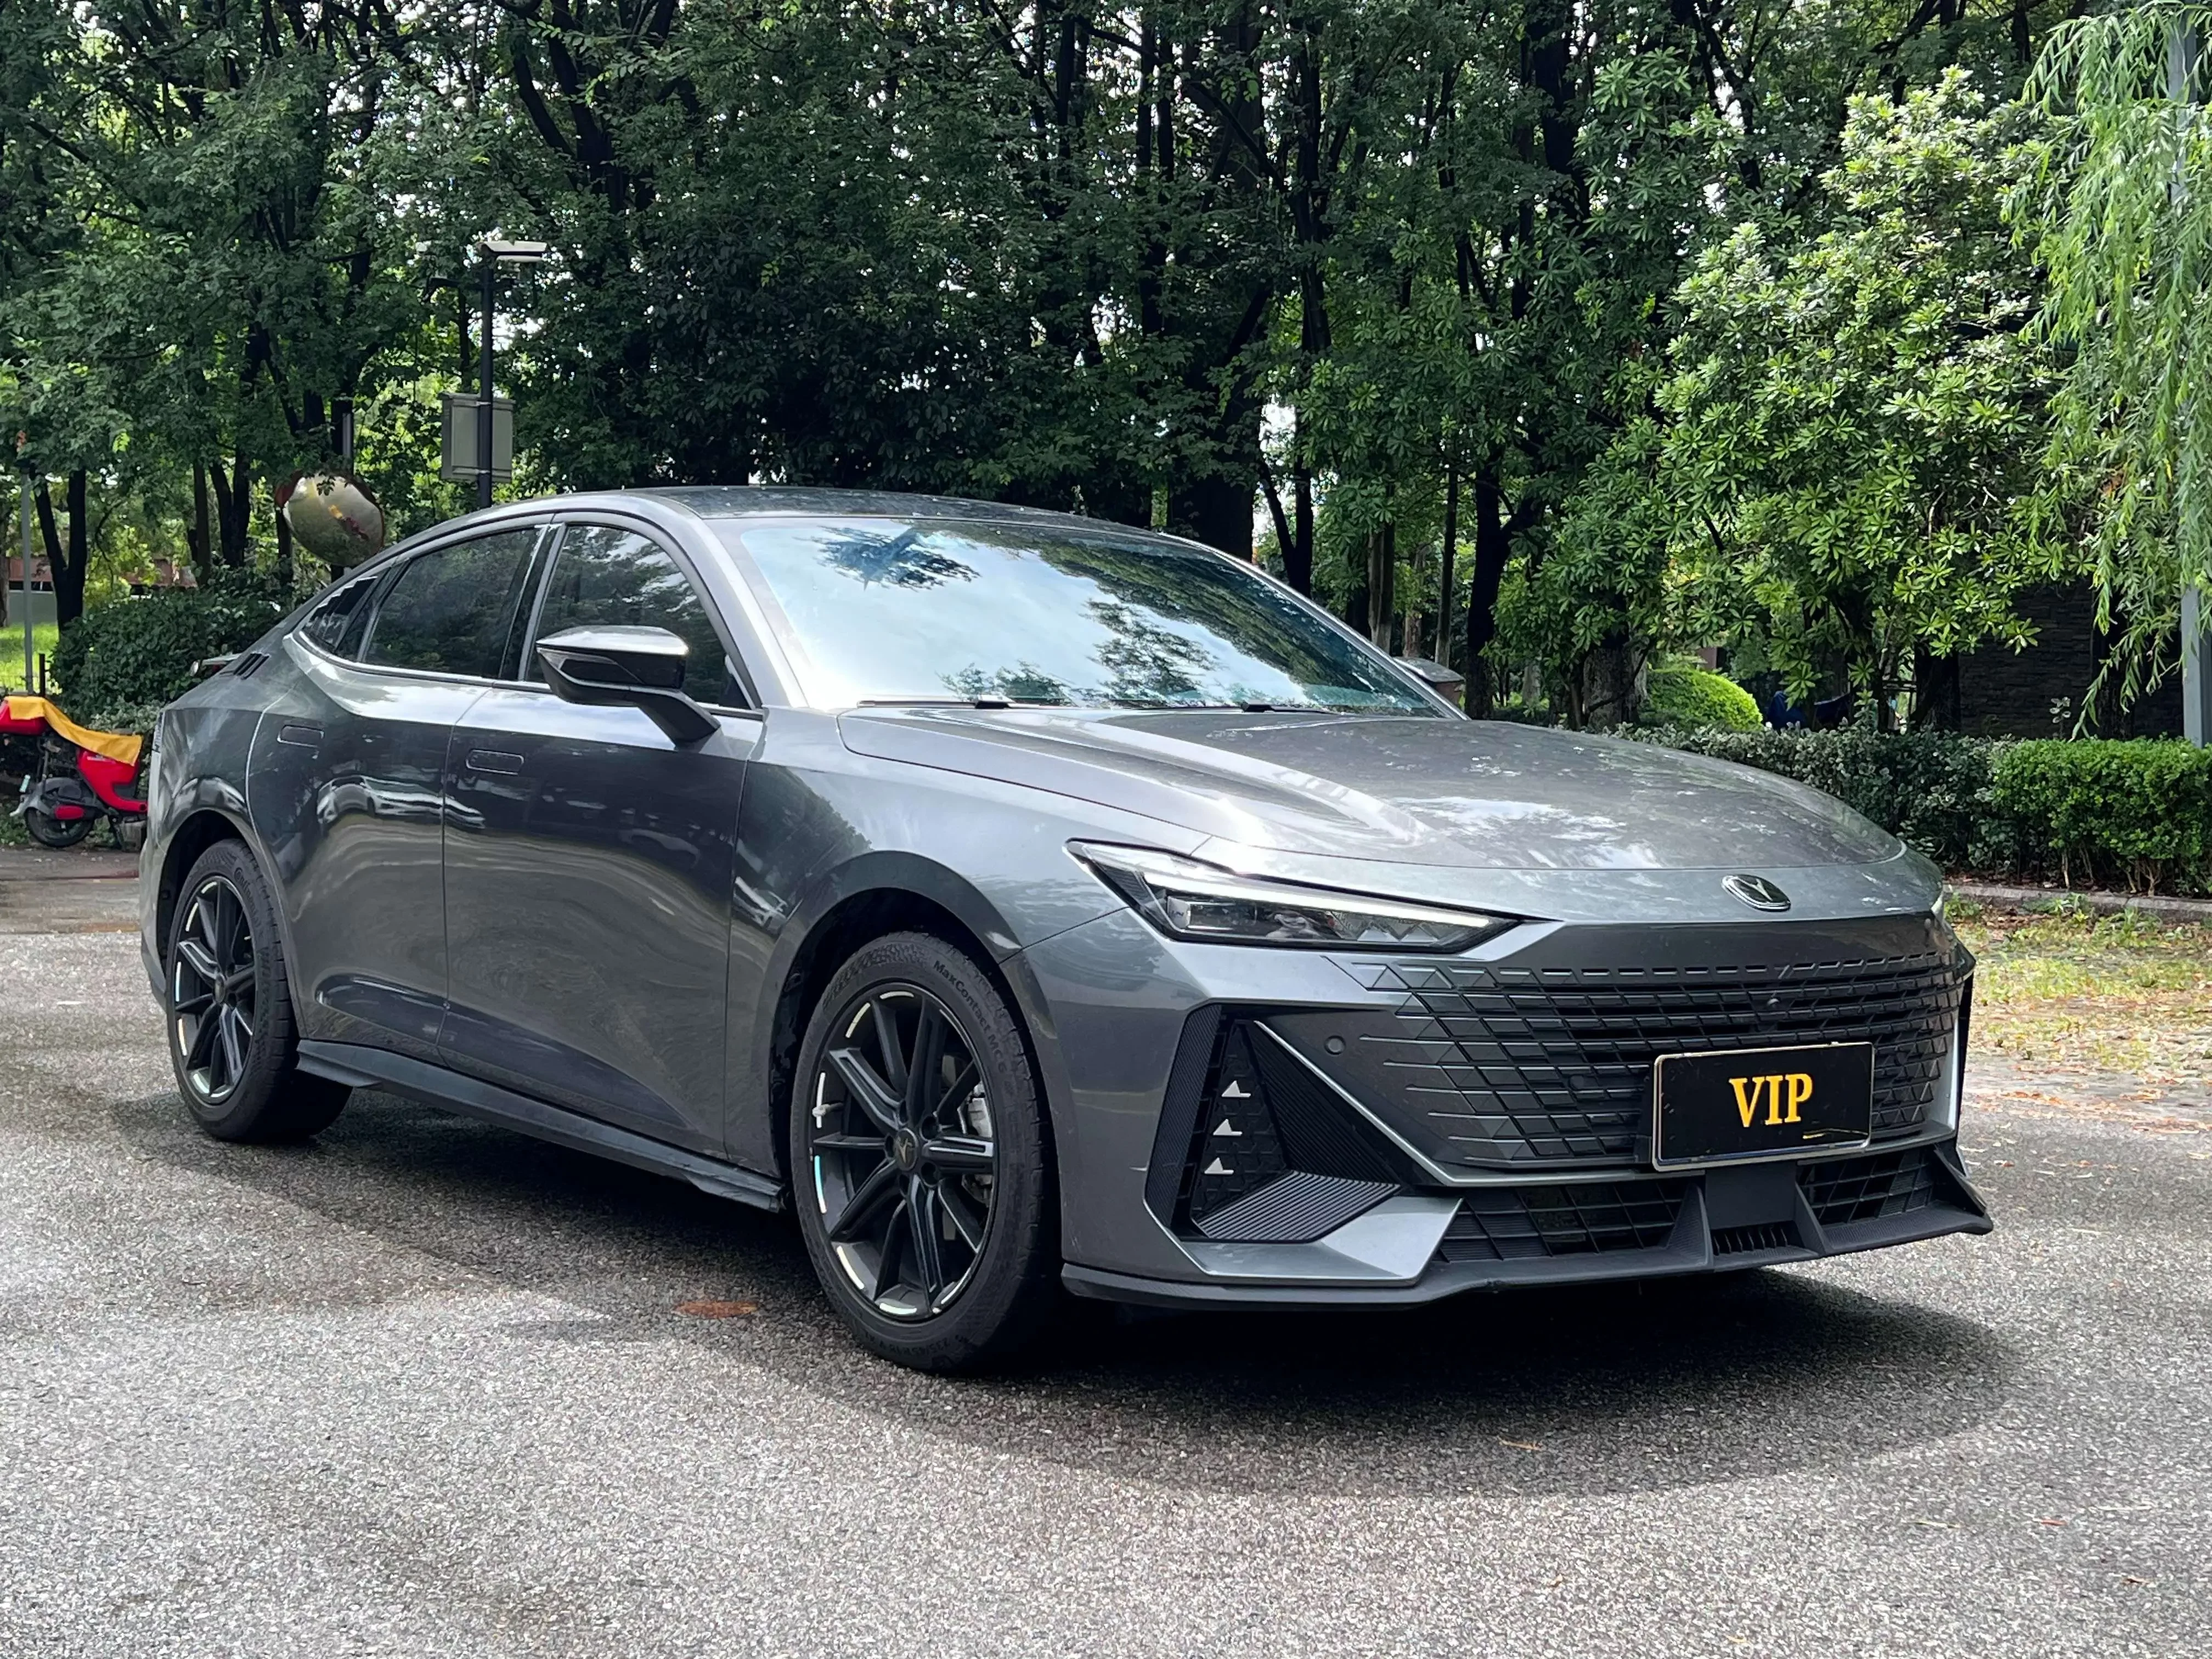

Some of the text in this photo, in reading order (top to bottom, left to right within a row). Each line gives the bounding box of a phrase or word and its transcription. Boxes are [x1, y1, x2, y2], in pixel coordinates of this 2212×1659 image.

[934, 960, 1007, 1073] MaxContact MC6
[1728, 1073, 1813, 1128] VIP
